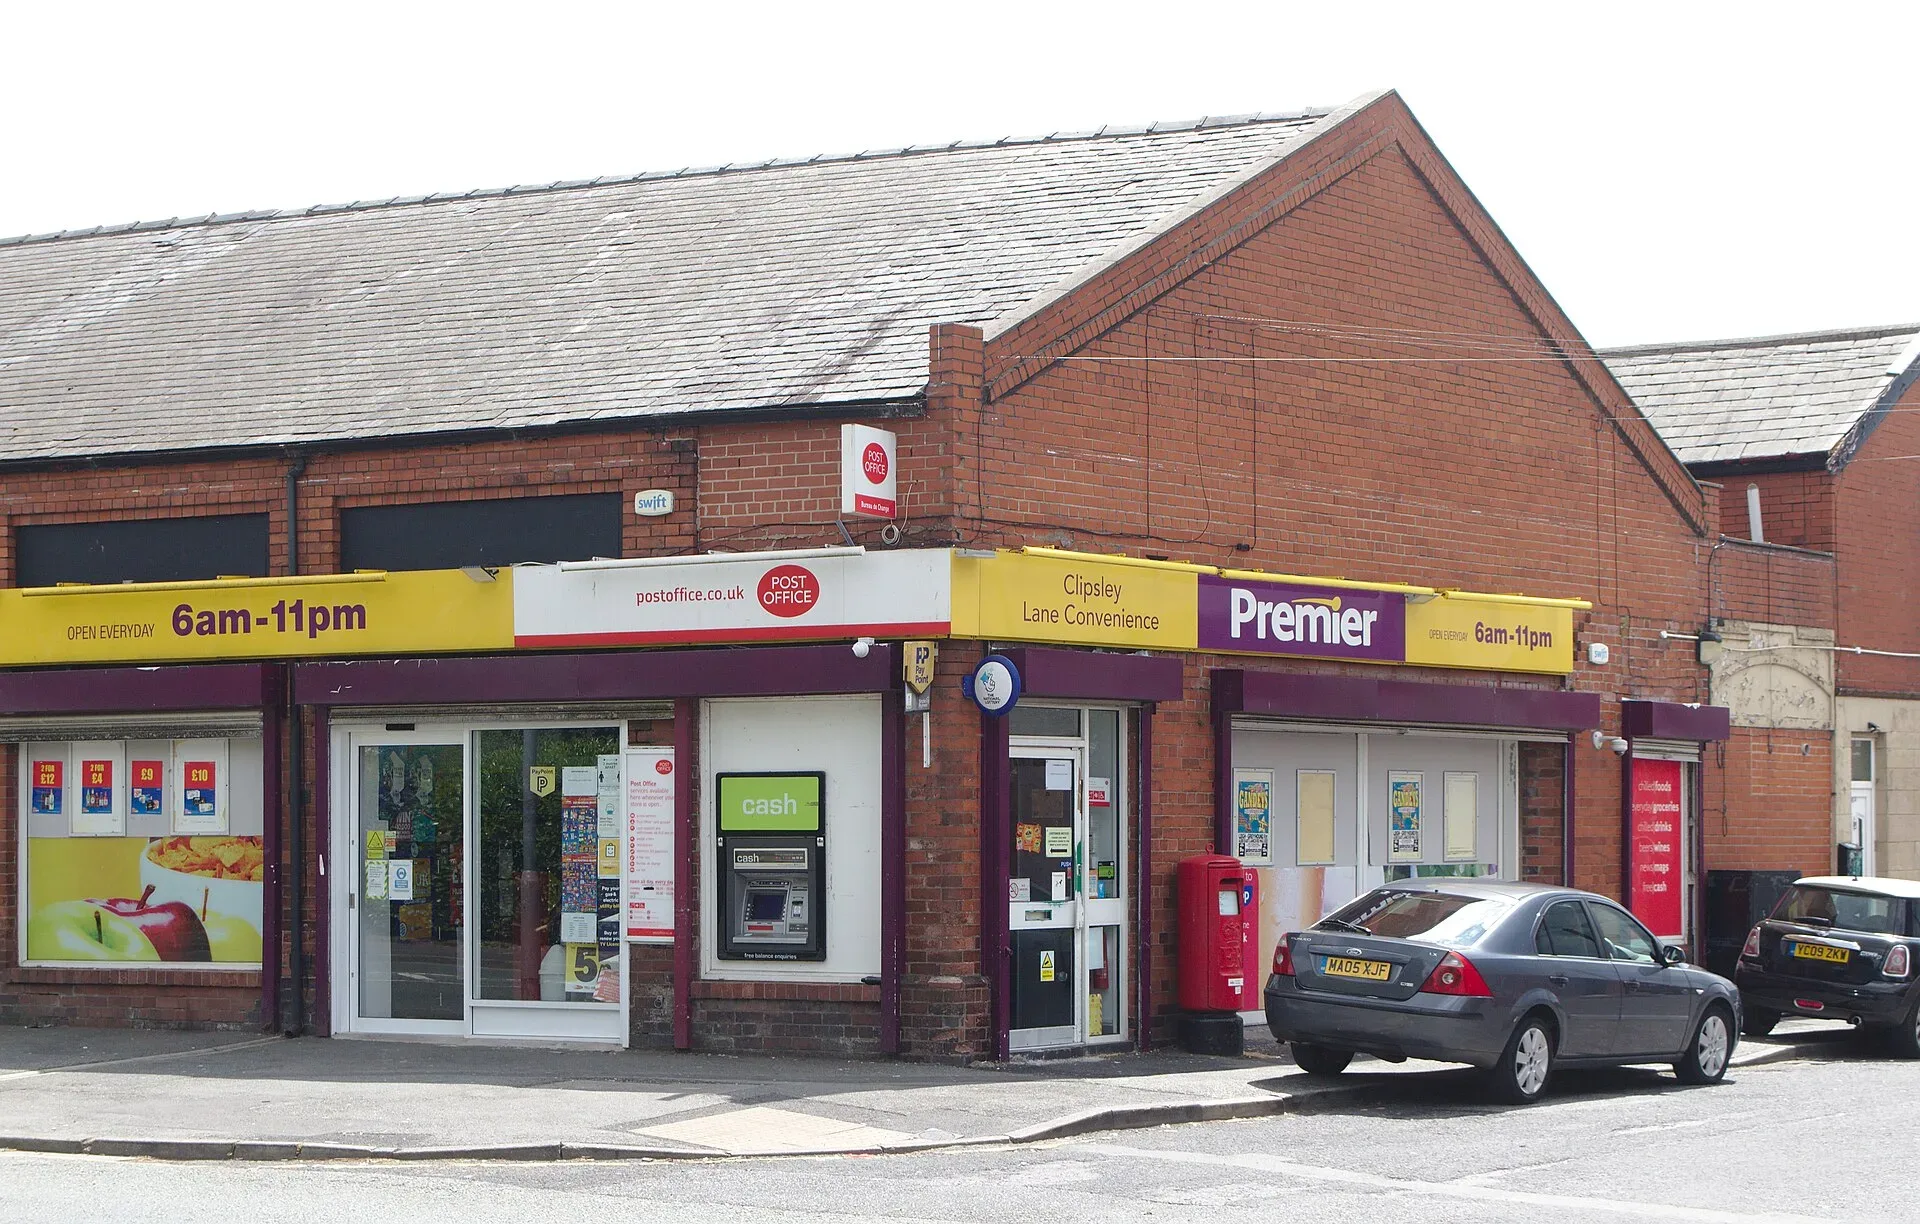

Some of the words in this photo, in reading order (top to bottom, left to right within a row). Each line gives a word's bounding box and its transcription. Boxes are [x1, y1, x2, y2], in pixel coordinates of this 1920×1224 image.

[868, 450, 884, 463] POST
[864, 461, 886, 475] OFFICE
[639, 494, 667, 511] swift
[861, 501, 873, 509] Bureau
[878, 503, 890, 514] Change
[771, 575, 808, 590] POST
[1063, 573, 1122, 604] Clipsley
[636, 586, 745, 606] postoffice.co.uk
[763, 590, 813, 605] OFFICE
[68, 625, 97, 641] OPEN
[100, 623, 155, 640] EVERYDAY
[171, 599, 367, 640] 6am-11pm
[1023, 601, 1060, 624] Lane
[1064, 604, 1160, 630] Convenience
[1230, 587, 1379, 648] Premier
[1428, 629, 1443, 641] OPEN
[1443, 630, 1469, 643] EVERYDAY
[1475, 621, 1553, 652] 6am-11pm
[915, 665, 926, 676] Pay
[915, 675, 929, 684] Point
[46, 764, 55, 772] FOR
[95, 764, 105, 772] FOR
[141, 768, 154, 781] £9
[40, 773, 56, 785] £12
[92, 772, 103, 785] £4
[191, 768, 208, 782] £10
[642, 780, 657, 788] Office
[649, 787, 670, 795] available
[642, 794, 665, 802] whenever
[742, 792, 798, 816] cash
[737, 852, 760, 863] cash
[601, 885, 609, 893] Pay
[755, 952, 774, 960] balance
[774, 953, 798, 961] enquiries
[1797, 944, 1824, 957] YC09
[1825, 948, 1849, 961] ZKW
[1328, 958, 1360, 975] MA05
[1361, 962, 1388, 978] XJF
